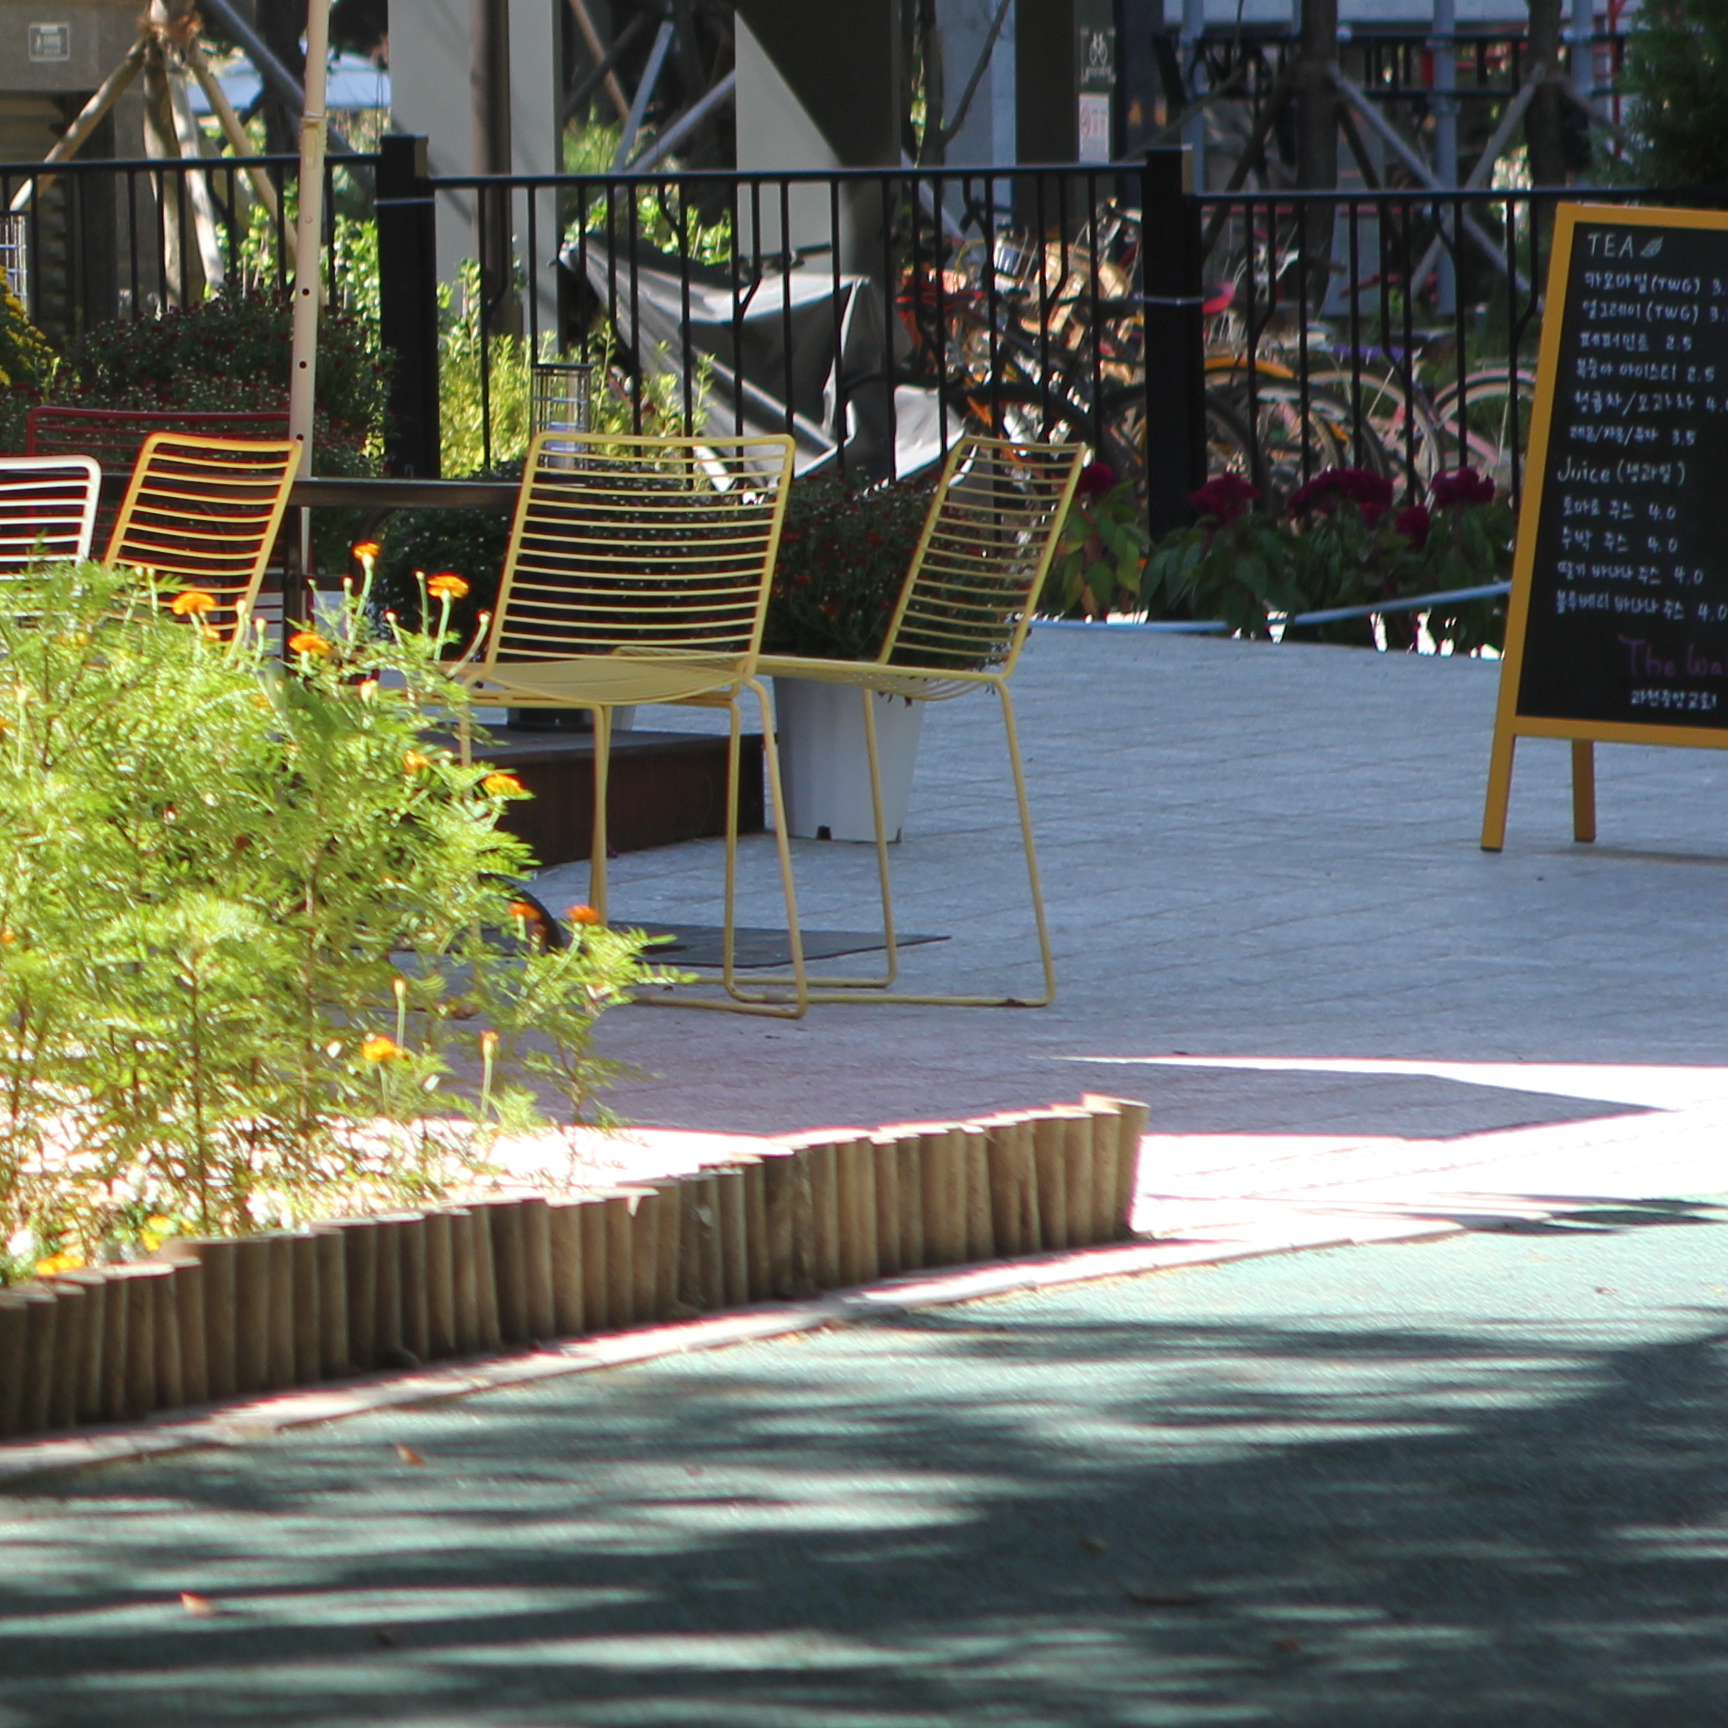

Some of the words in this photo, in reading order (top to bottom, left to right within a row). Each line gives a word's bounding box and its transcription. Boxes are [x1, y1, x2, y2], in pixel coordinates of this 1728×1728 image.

[1587, 232, 1634, 259] TEA
[1577, 357, 1613, 380] 복숭아
[1619, 362, 1676, 381] 아이스티
[1557, 455, 1611, 484] Juice
[1563, 495, 1600, 516] 토마토
[1609, 499, 1635, 520] 주스
[1648, 501, 1676, 520] 4.0
[1562, 525, 1593, 552] 수박
[1604, 531, 1629, 552] 주스
[1647, 535, 1678, 553] 4.0
[1592, 564, 1633, 581] 바나나
[1638, 566, 1661, 585] 주스
[1674, 566, 1704, 585] 4.0
[1614, 595, 1658, 614] 바나나
[1663, 599, 1684, 620] 주스
[1698, 603, 1728, 622] 4.0
[1618, 633, 1676, 677] The
